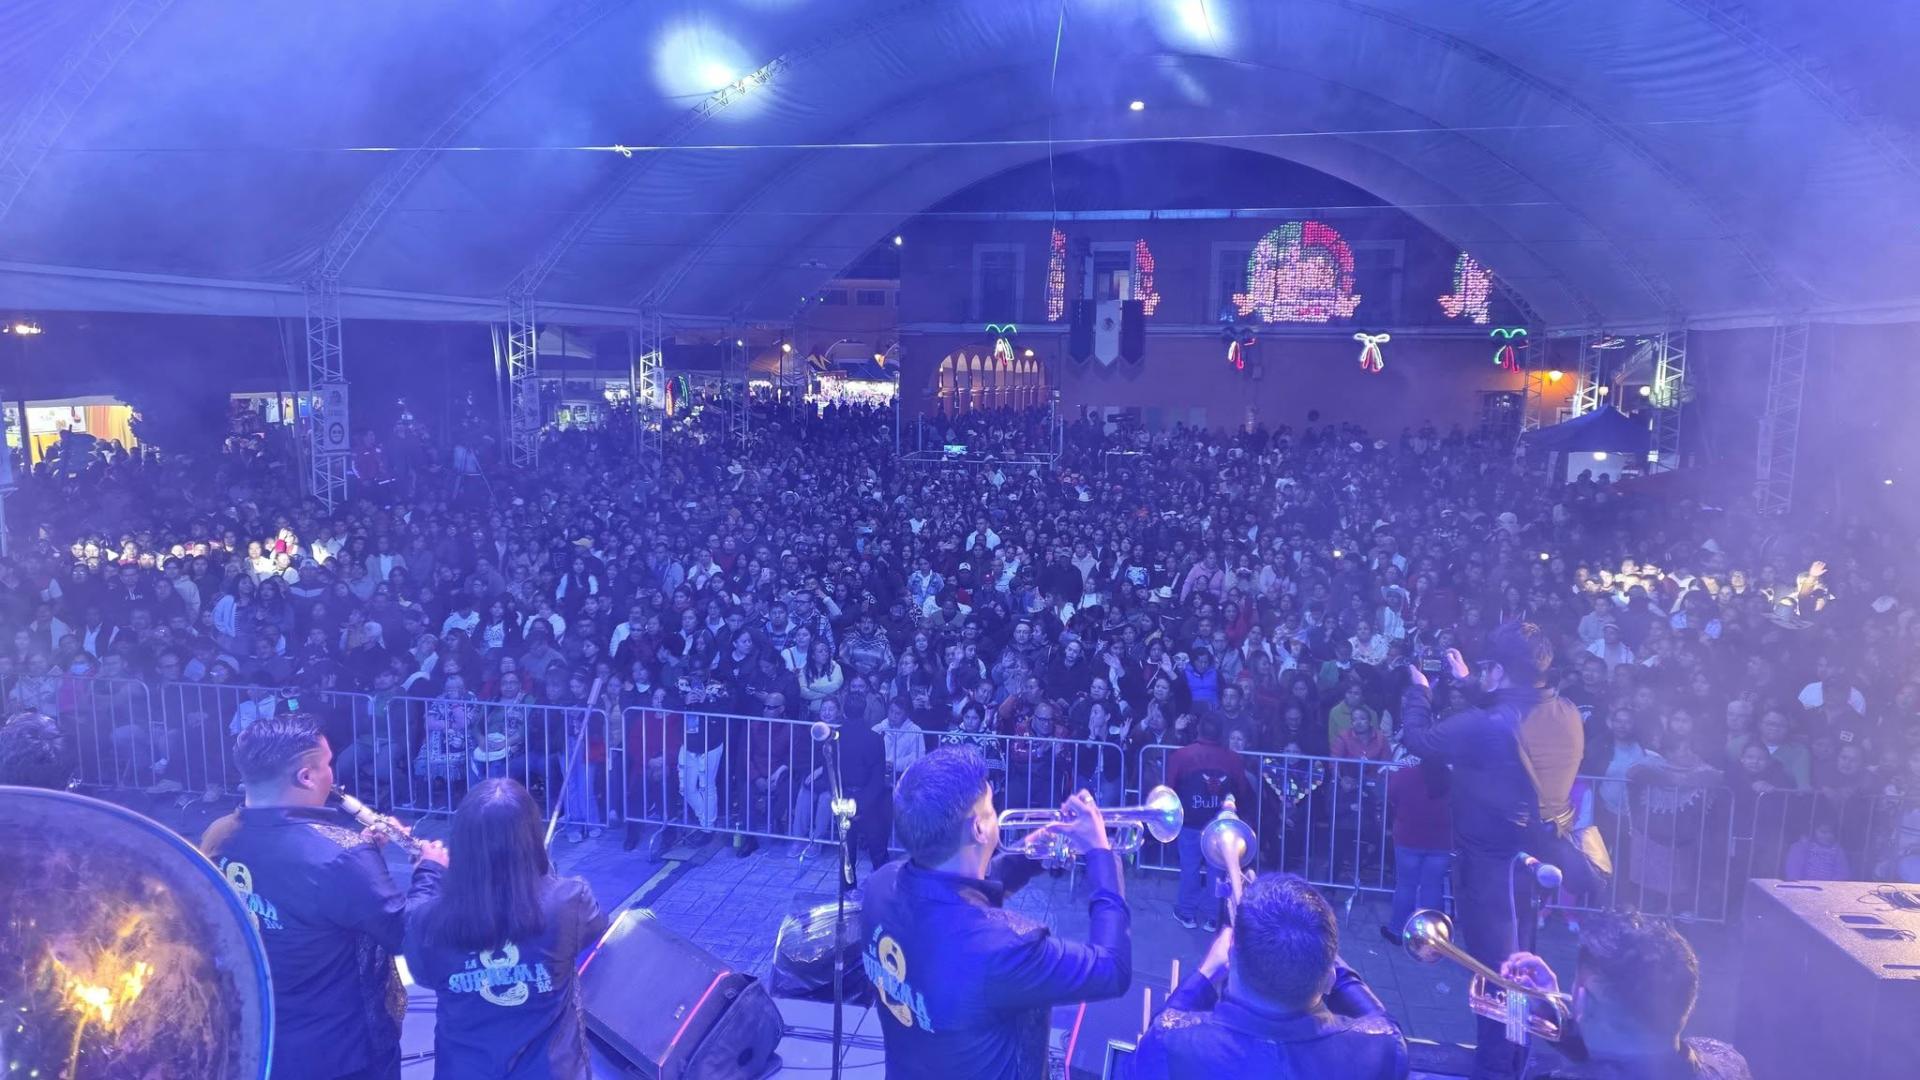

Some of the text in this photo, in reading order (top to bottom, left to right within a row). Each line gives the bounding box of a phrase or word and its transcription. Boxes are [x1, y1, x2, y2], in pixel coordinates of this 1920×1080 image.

[1191, 794, 1218, 809] Bull
[464, 958, 477, 970] LA
[448, 963, 551, 994] SUPREMA
